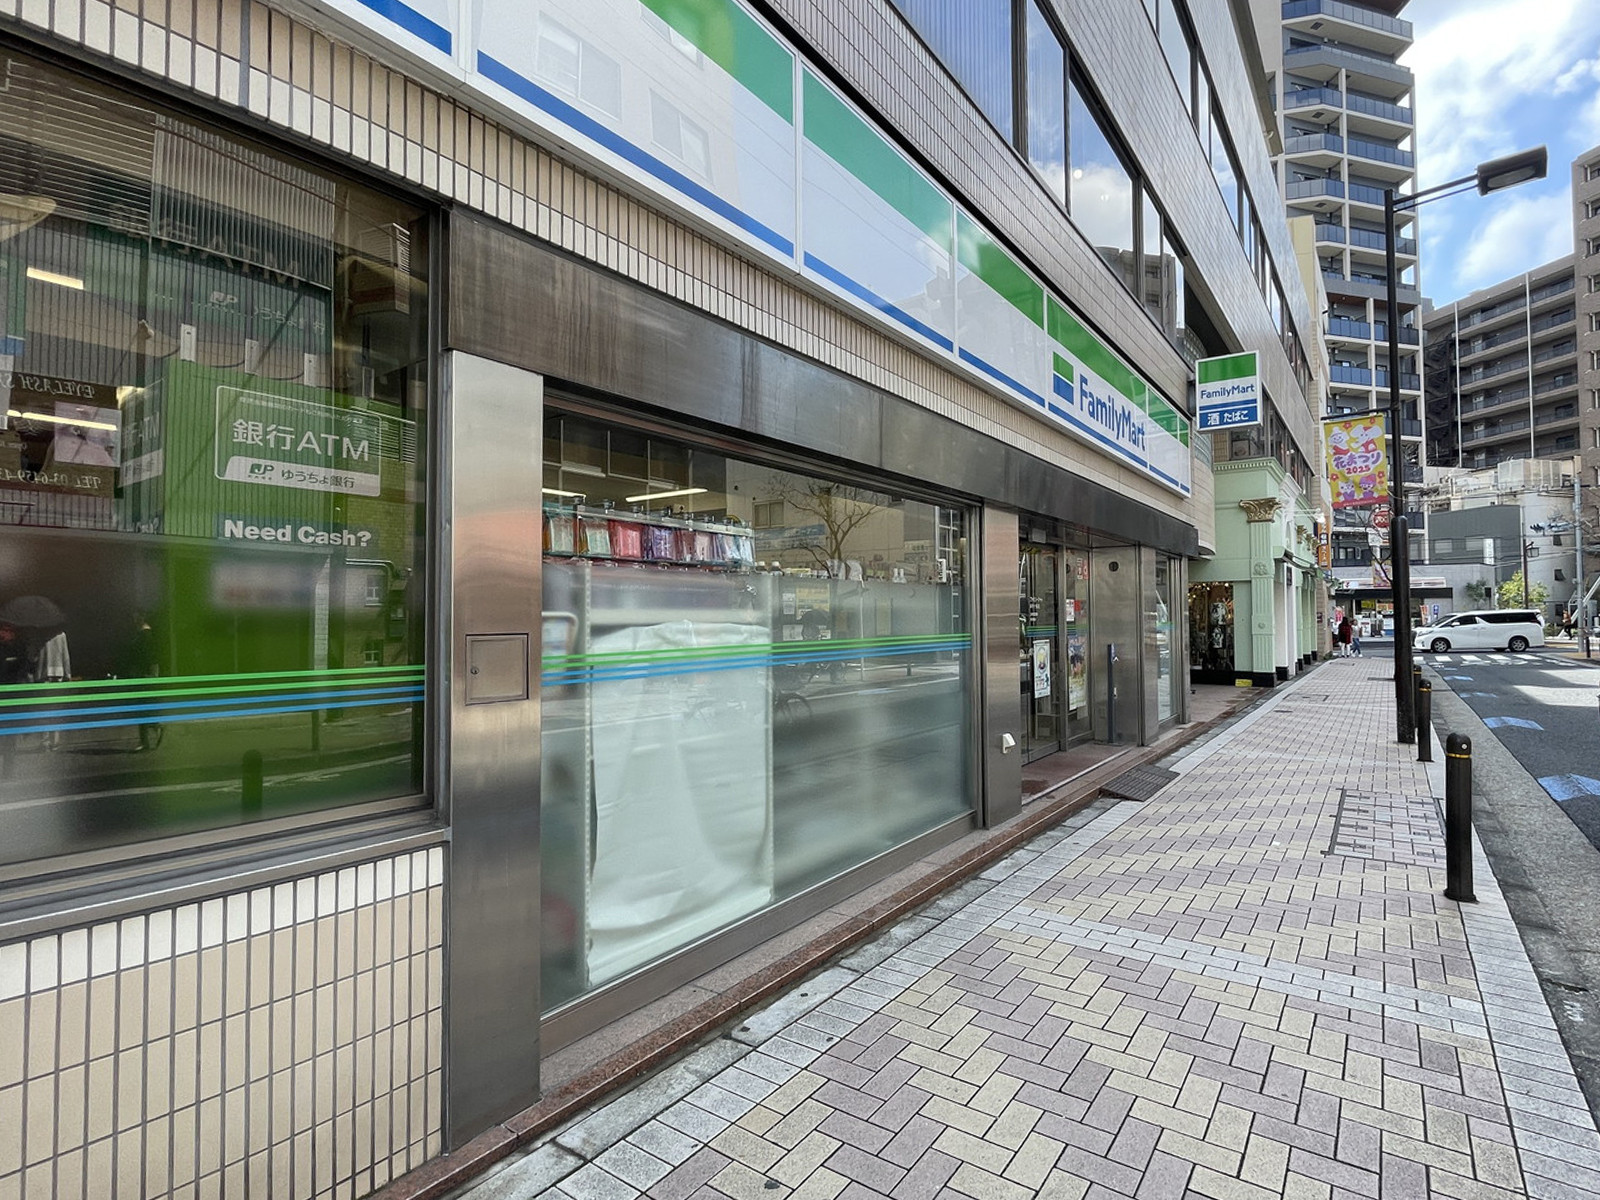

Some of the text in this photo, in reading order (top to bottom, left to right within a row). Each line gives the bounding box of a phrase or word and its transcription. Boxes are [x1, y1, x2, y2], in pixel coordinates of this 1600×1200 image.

[1200, 384, 1255, 399] FamilyMart
[1080, 373, 1145, 451] FamilyMart
[1207, 410, 1249, 426] 酒 たばこ
[232, 418, 369, 462] 銀行ATM
[1333, 451, 1381, 470] 花まつり
[1345, 465, 1371, 475] 2025
[281, 468, 355, 489] ゆうちょ銀行
[224, 519, 372, 547] Need Cash?
